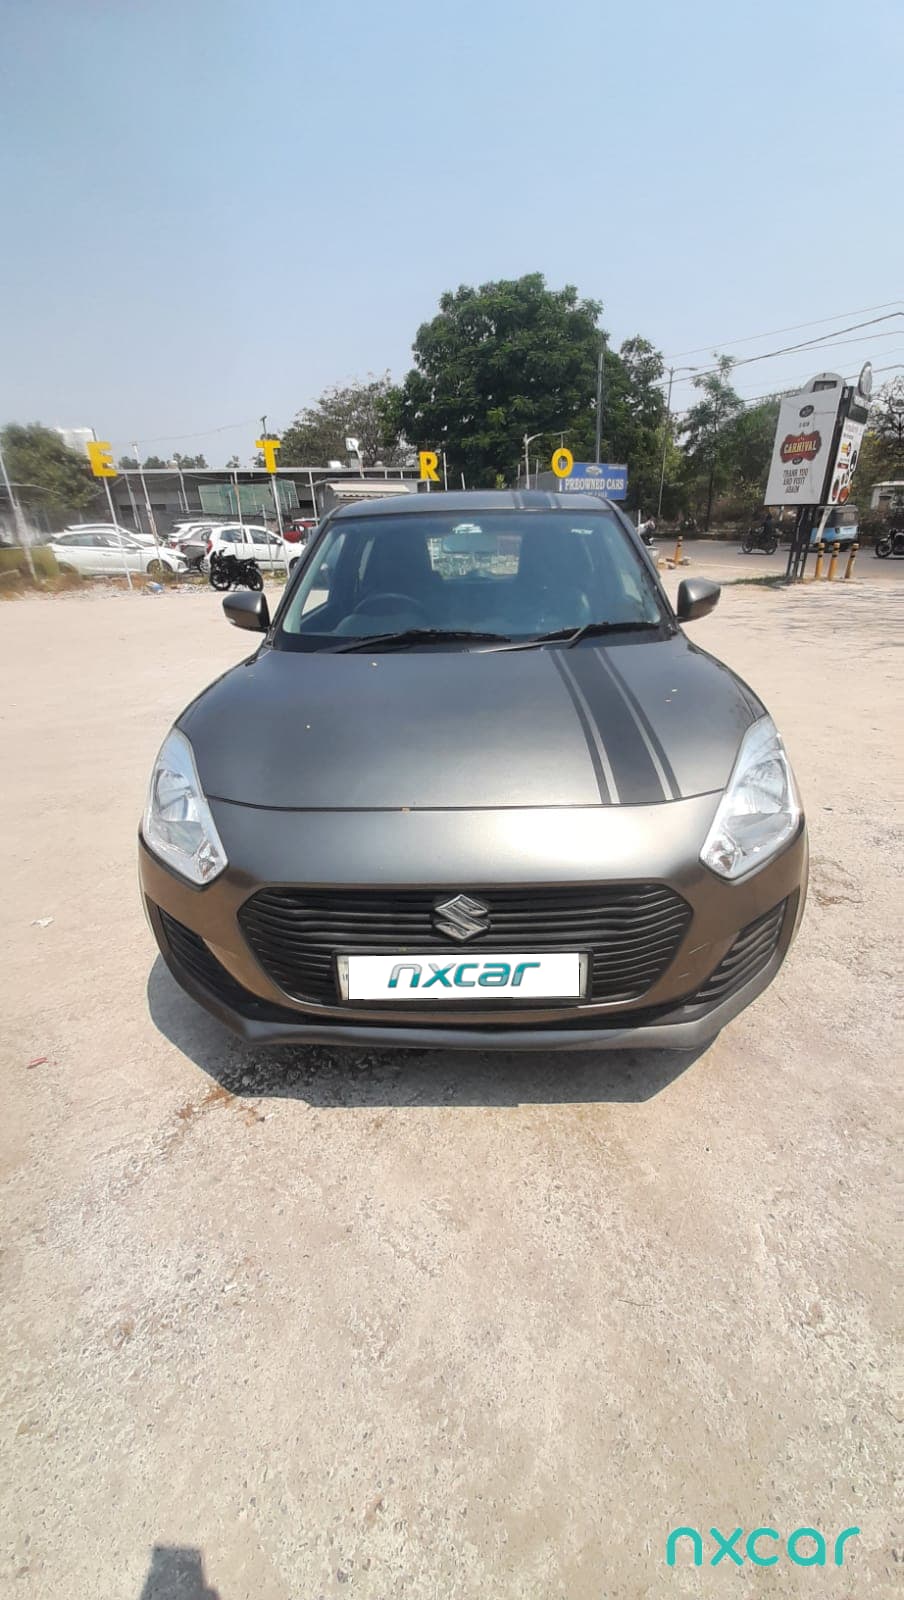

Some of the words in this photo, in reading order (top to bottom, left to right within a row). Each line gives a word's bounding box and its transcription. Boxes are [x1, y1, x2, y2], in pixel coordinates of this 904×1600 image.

[783, 440, 817, 454] CARNIVAL
[87, 440, 118, 477] E
[255, 439, 281, 473] T
[419, 451, 440, 482] R
[551, 447, 574, 478] O
[783, 468, 798, 477] THANK
[799, 468, 809, 476] YOU
[564, 478, 605, 490] PREOWNED
[606, 478, 624, 490] CARS
[783, 478, 793, 486] AND
[793, 477, 805, 485] VISIT
